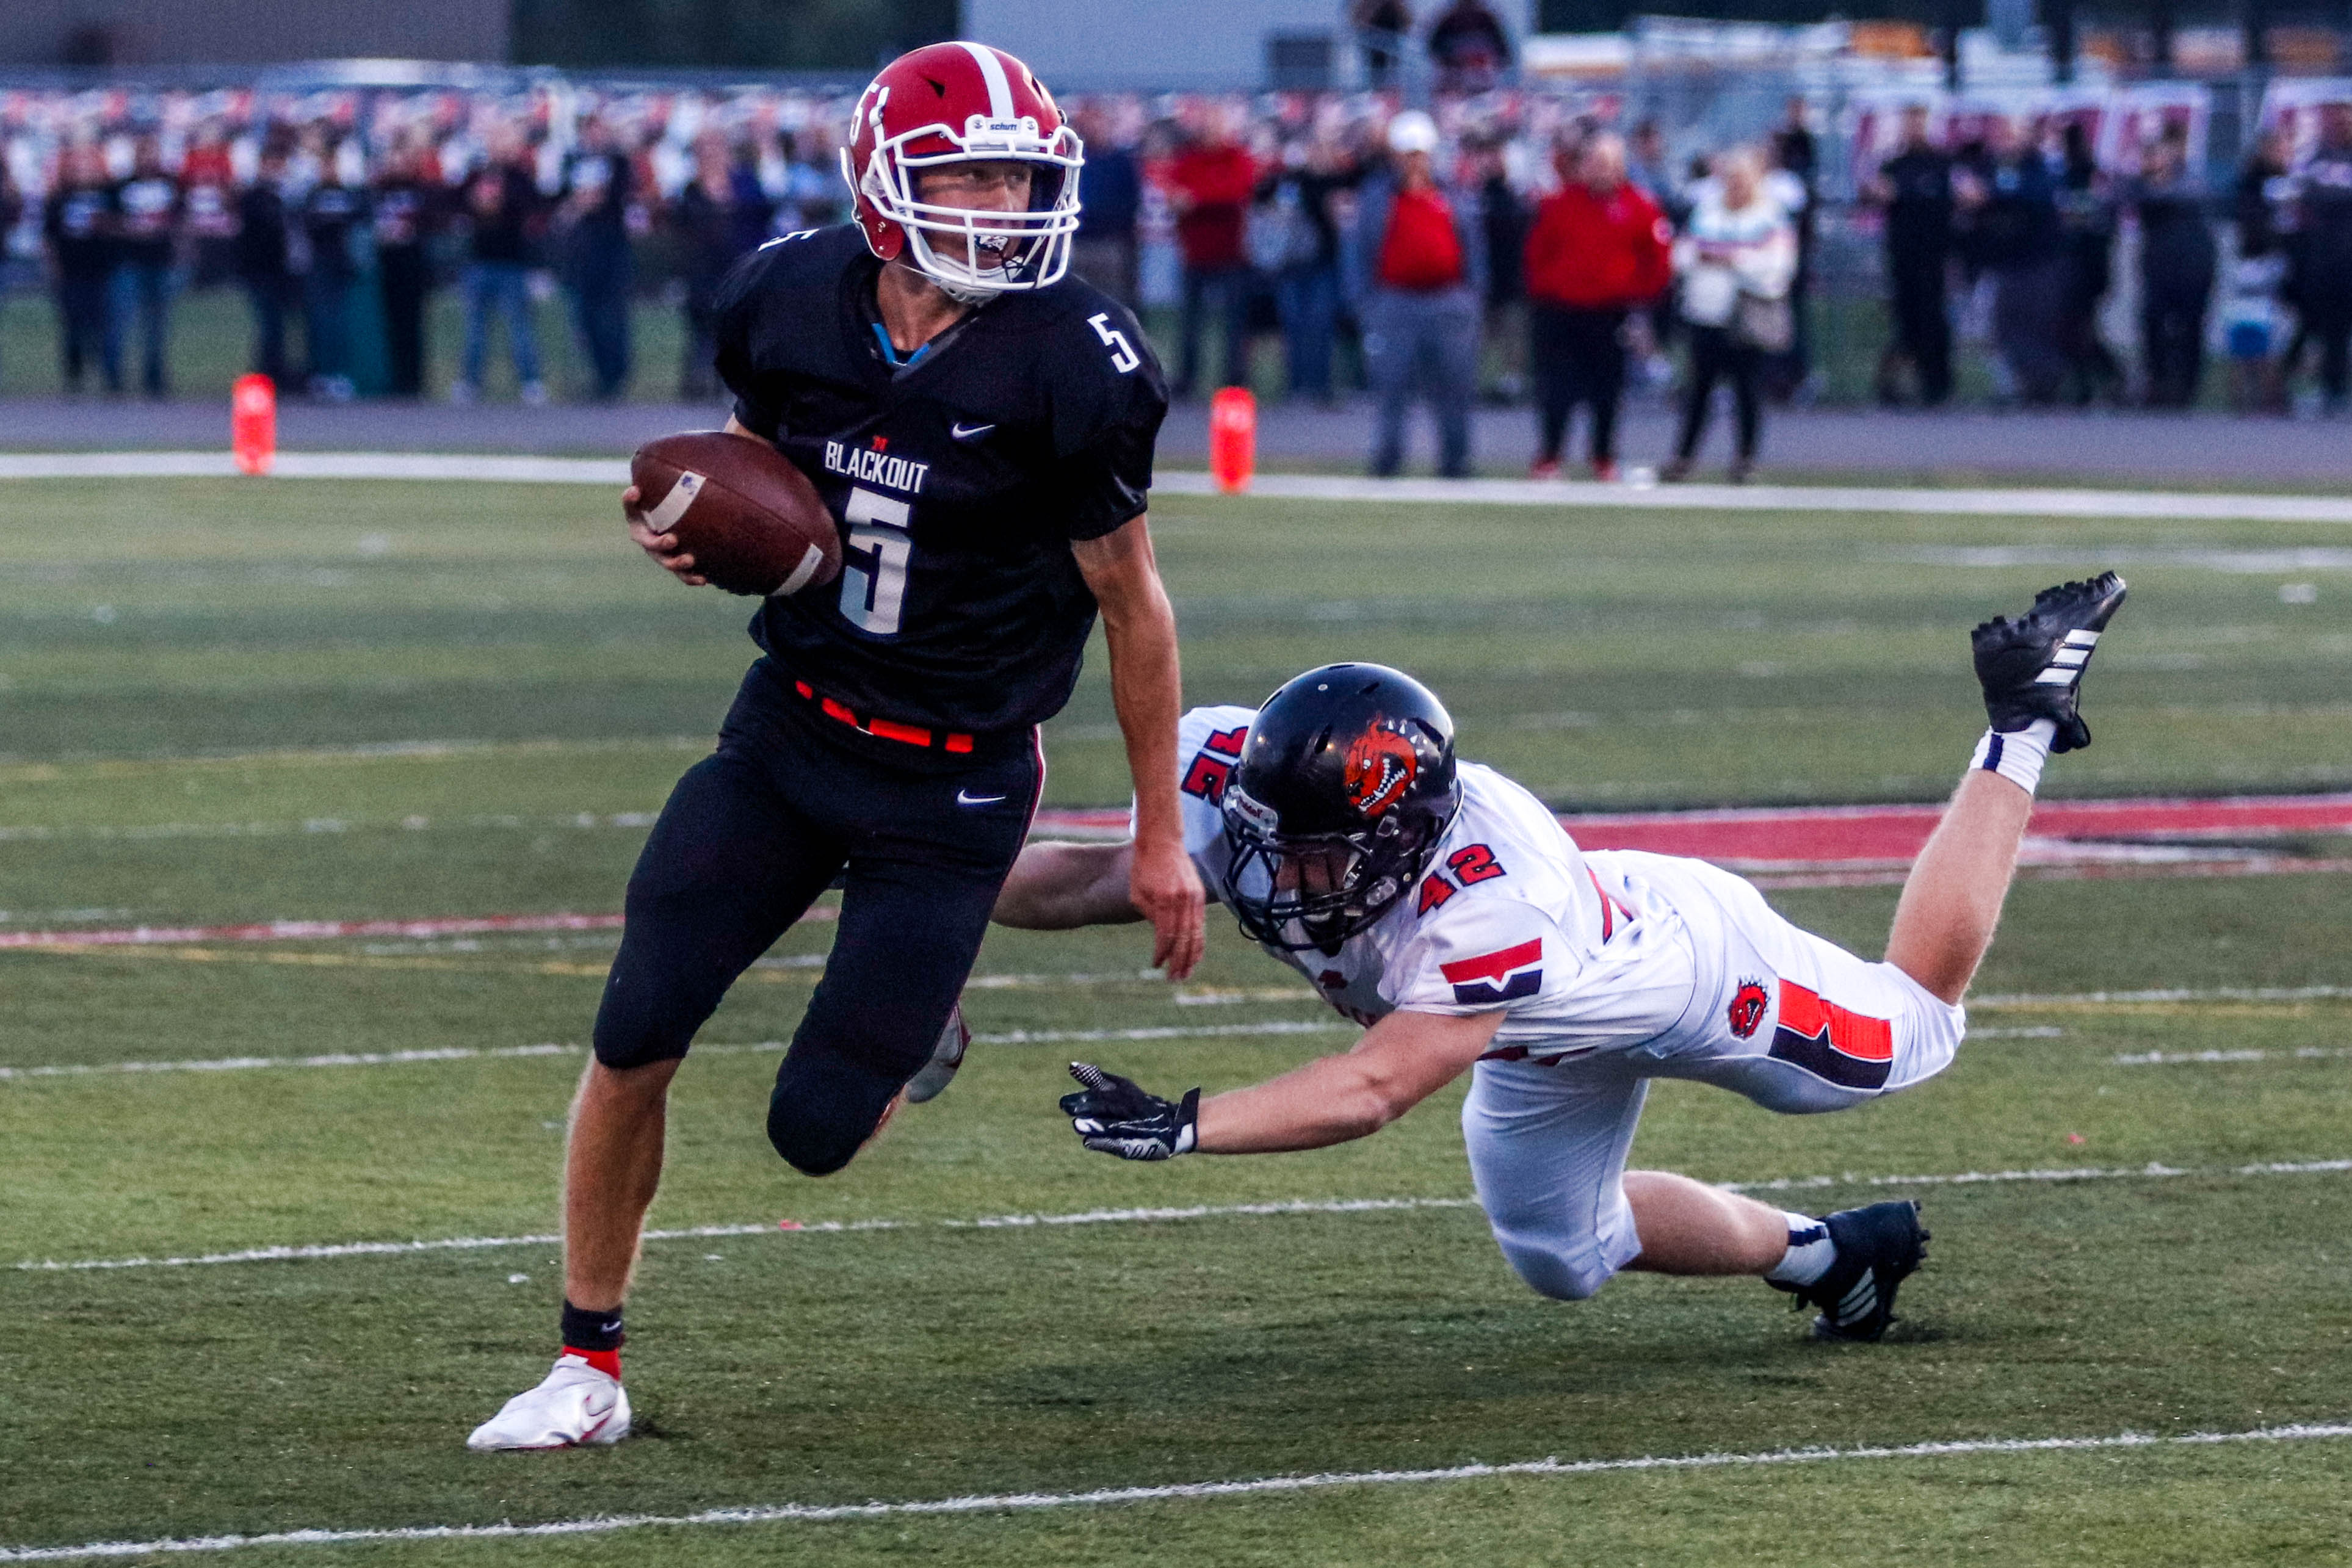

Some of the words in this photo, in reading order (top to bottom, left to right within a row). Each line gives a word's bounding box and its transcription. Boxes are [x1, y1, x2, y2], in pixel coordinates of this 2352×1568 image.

[990, 122, 1018, 131] schutt
[1087, 313, 1141, 374] 5
[825, 440, 928, 493] BLACKOUT
[839, 486, 911, 635] 5
[1417, 844, 1507, 919] 42
